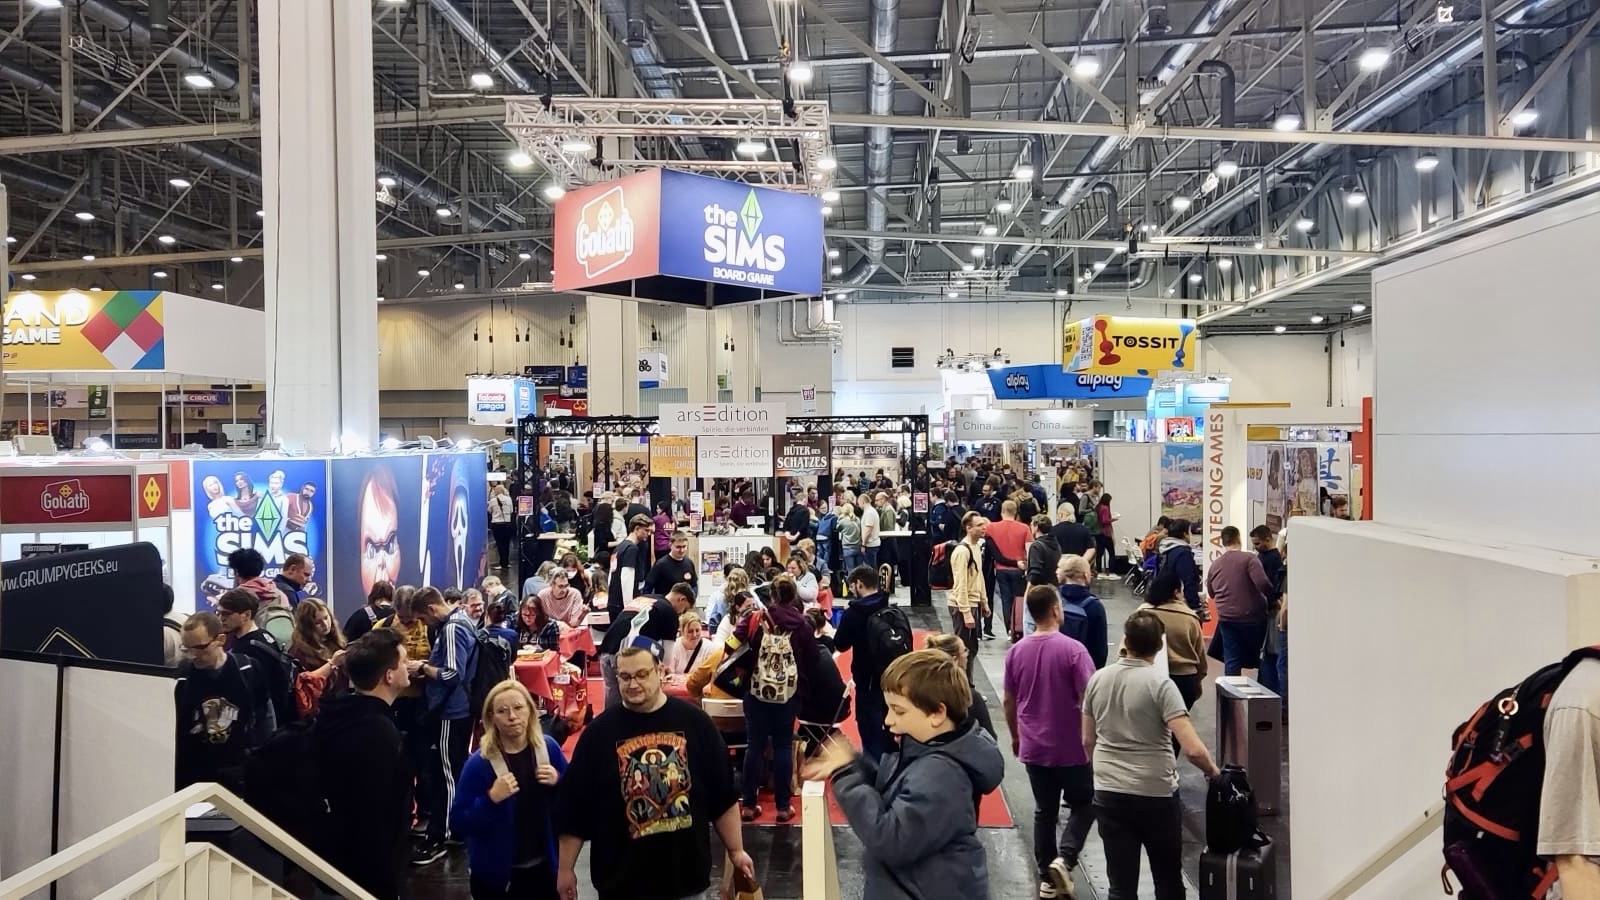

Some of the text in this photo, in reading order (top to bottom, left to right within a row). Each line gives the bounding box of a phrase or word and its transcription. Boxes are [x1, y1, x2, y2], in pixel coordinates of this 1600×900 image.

[703, 204, 737, 228] the
[578, 212, 631, 256] Goliath
[703, 227, 786, 271] SIMS
[713, 267, 774, 285] BOARD GAME
[1112, 335, 1179, 349] TOSSIT
[1006, 374, 1030, 391] allplay
[1078, 374, 1122, 391] allplay
[478, 403, 505, 411] juegos
[677, 405, 768, 422] arsEdition
[962, 421, 992, 431] China
[1031, 420, 1060, 430] China
[700, 445, 769, 458] arsEdition
[783, 444, 811, 456] HÜTER
[864, 446, 897, 455] EUROPE
[776, 456, 827, 468] SCHATZES
[43, 493, 88, 510] Goliath
[214, 512, 253, 532] the
[216, 531, 309, 566] SIMS
